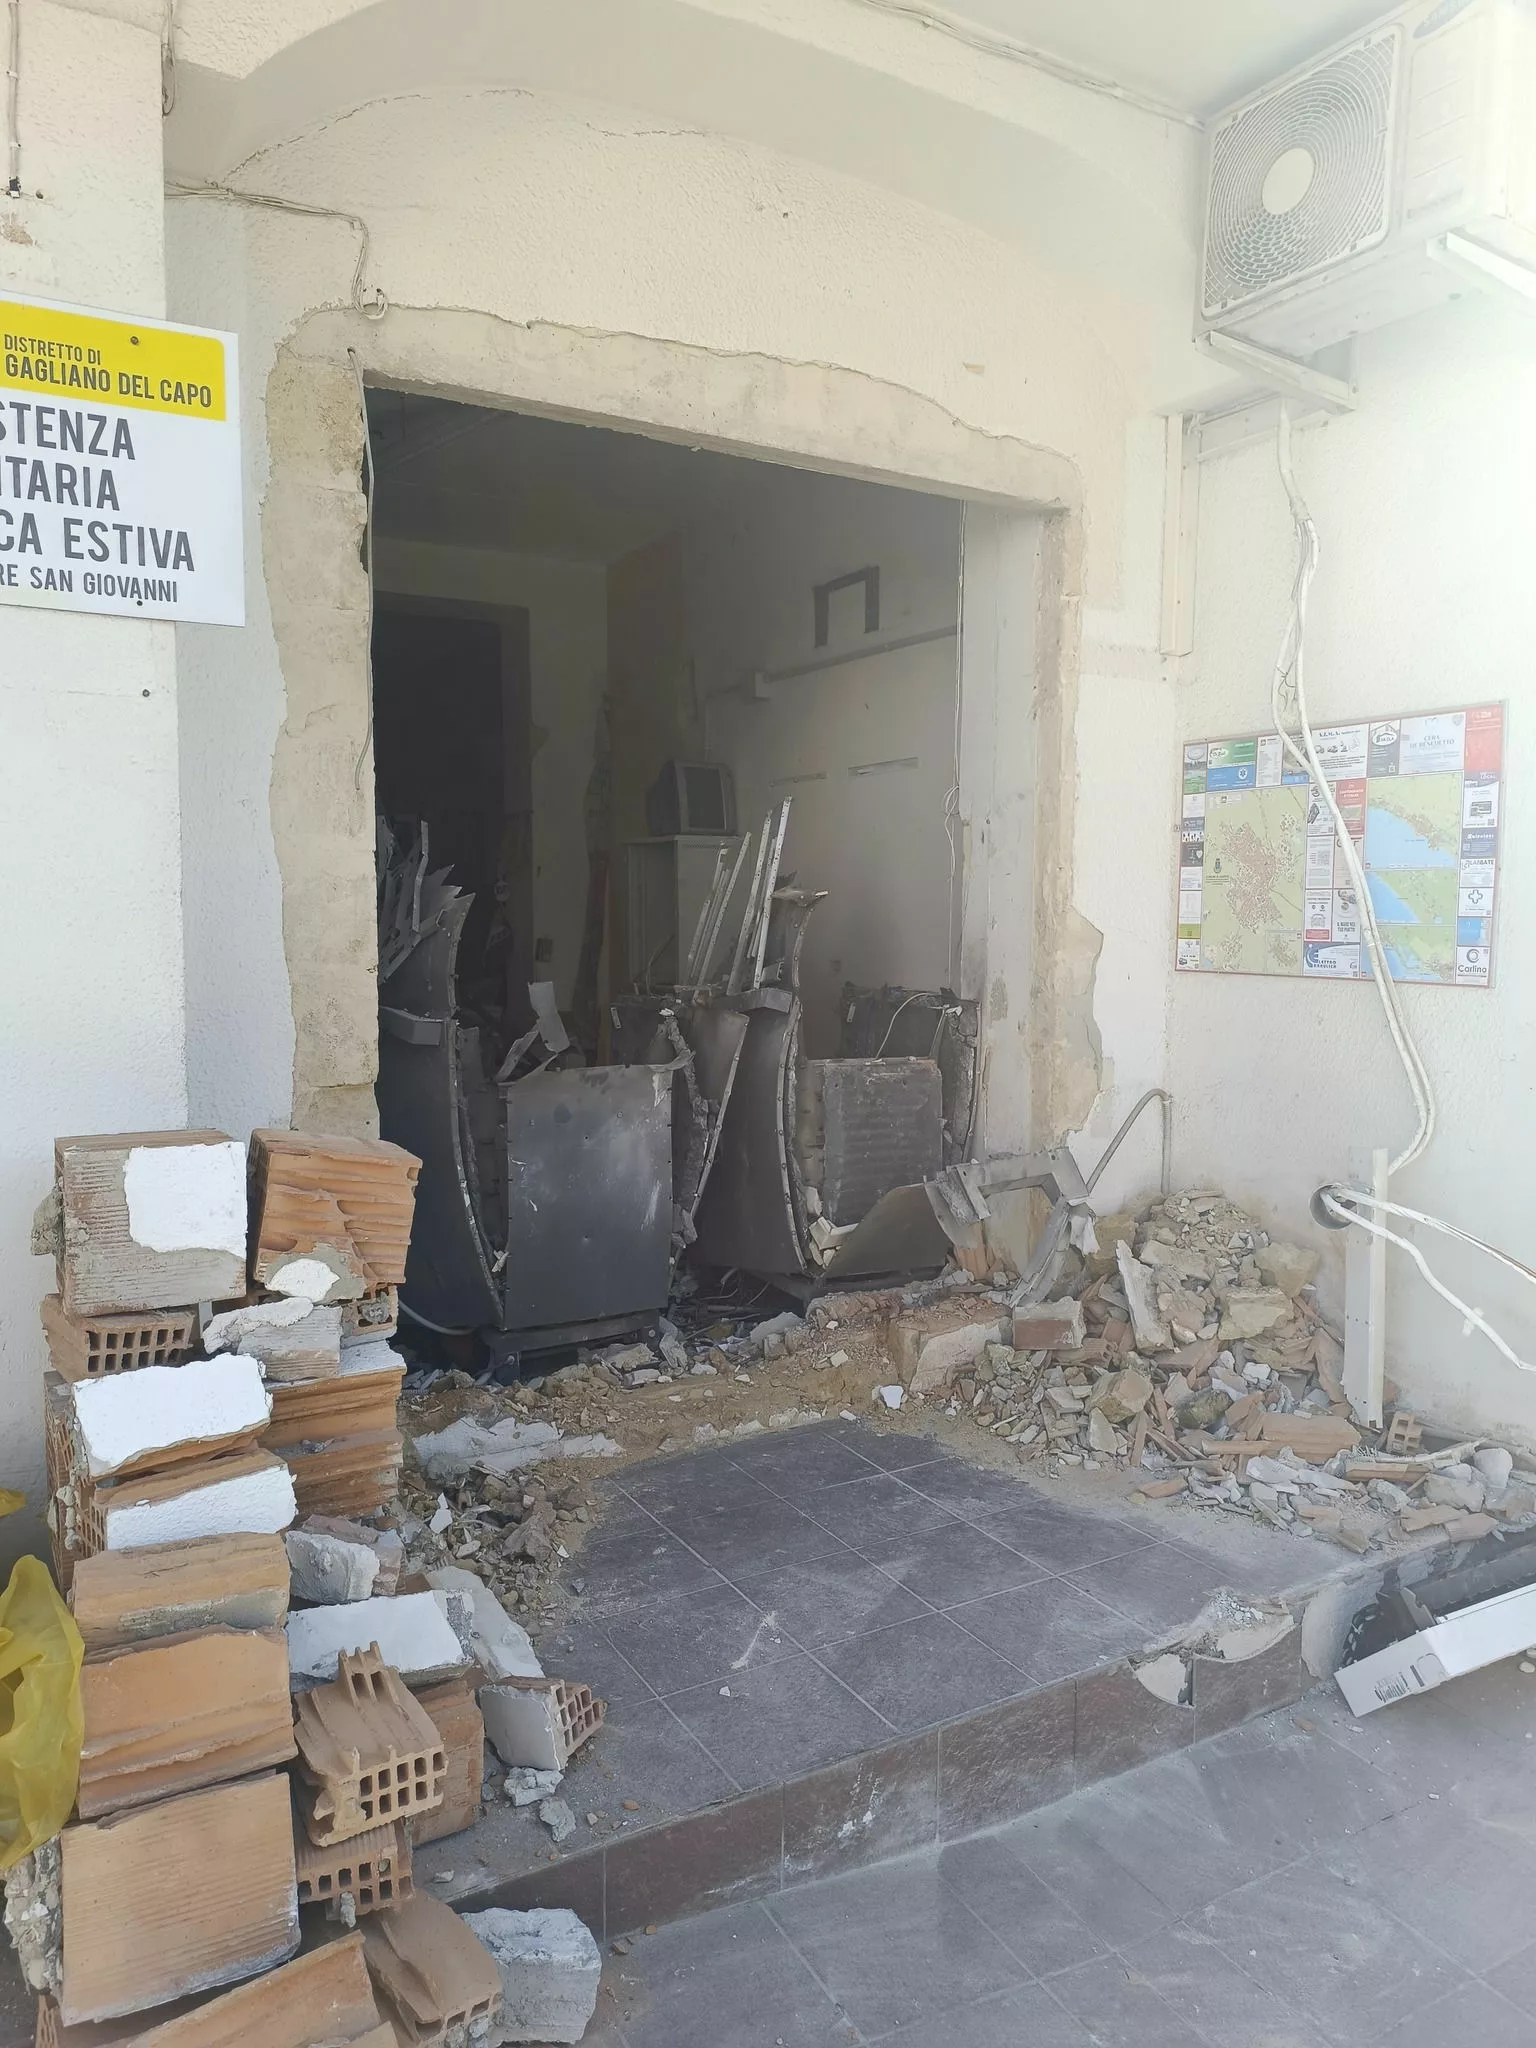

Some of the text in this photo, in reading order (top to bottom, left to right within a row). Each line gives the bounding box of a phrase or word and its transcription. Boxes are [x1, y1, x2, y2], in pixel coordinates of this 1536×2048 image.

[4, 334, 101, 366] DISTRETTO DI
[5, 354, 212, 408] GAGLIANO DEL CAPO
[0, 455, 120, 511] TARIA
[63, 517, 195, 571] ESTIVA
[30, 566, 73, 592] SAN
[83, 572, 178, 602] GIOVANNI
[1457, 964, 1487, 973] Carlino
